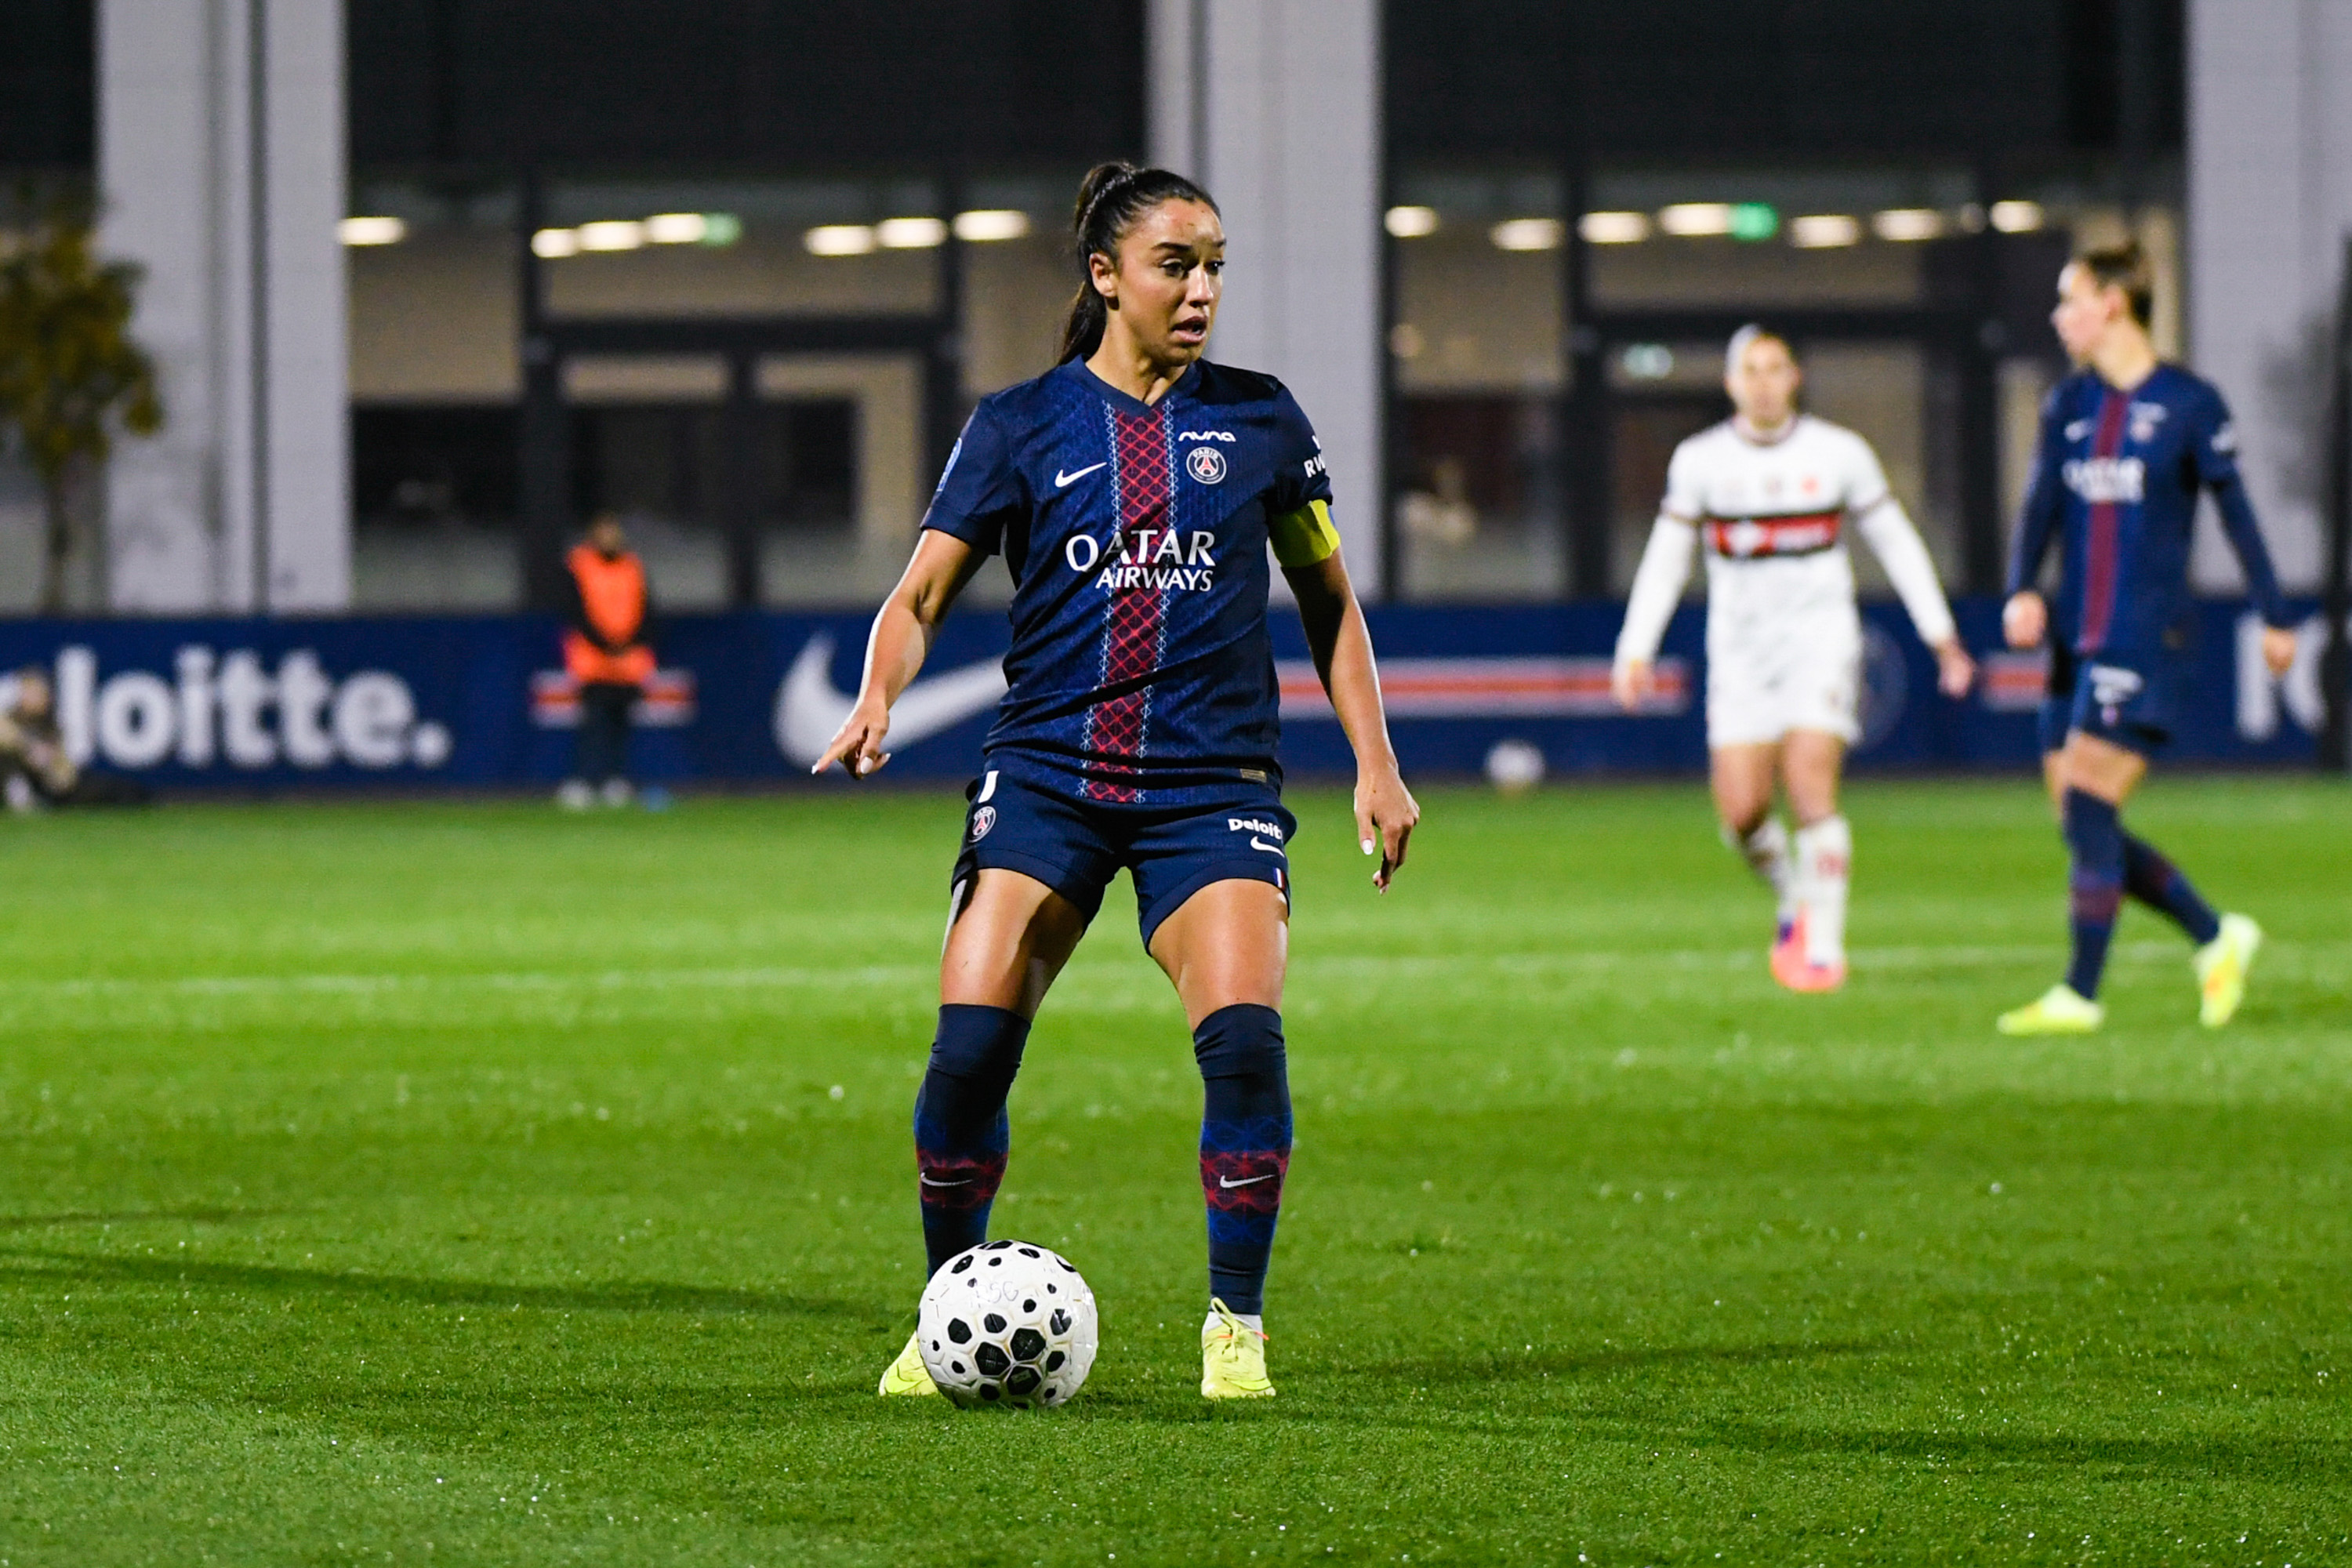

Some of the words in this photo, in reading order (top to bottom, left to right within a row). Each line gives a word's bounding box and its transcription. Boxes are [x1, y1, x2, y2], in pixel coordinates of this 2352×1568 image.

[1303, 453, 1326, 478] RW
[1065, 528, 1217, 573] QATAR
[1094, 566, 1214, 593] AIRWAYS
[55, 643, 453, 769] loitte.
[1227, 818, 1283, 841] Deloit
